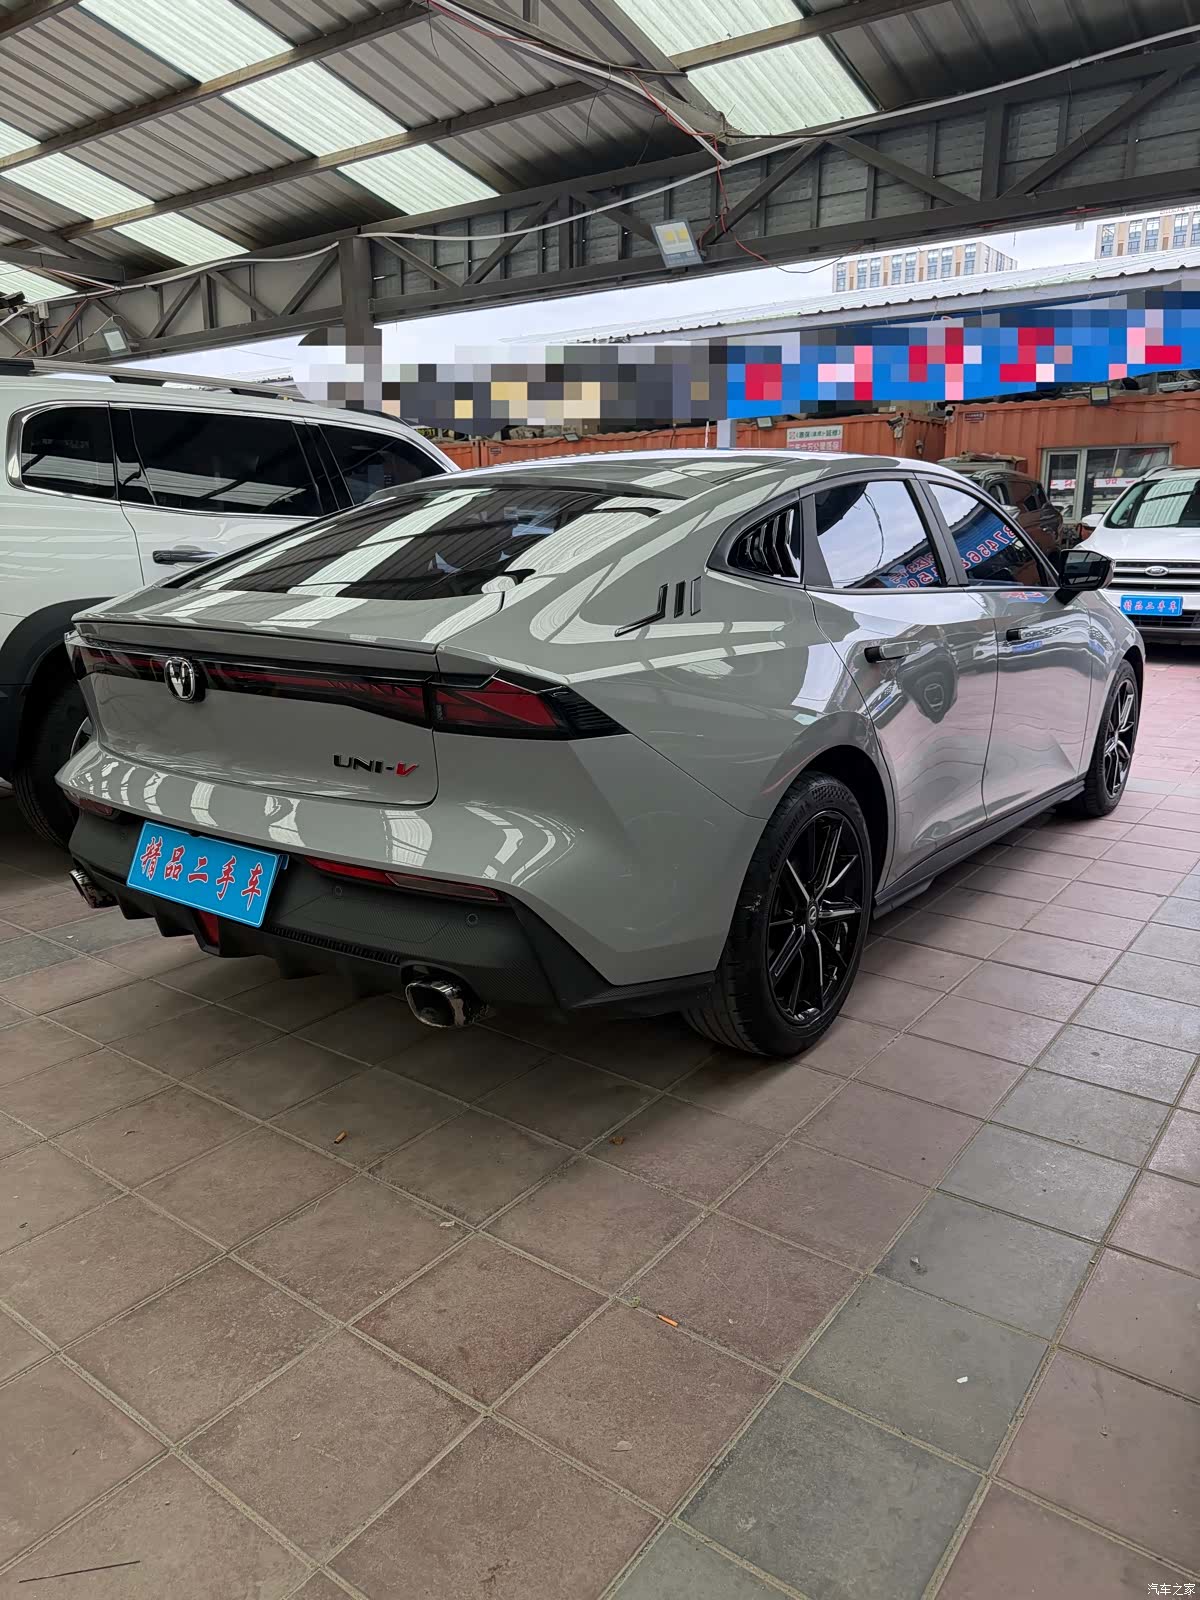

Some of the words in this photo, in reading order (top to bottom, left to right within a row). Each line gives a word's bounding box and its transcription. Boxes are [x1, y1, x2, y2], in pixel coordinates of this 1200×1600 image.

[1123, 599, 1178, 614] 精品二手车
[333, 754, 419, 777] UNI-V
[139, 835, 264, 912] 精品二手车
